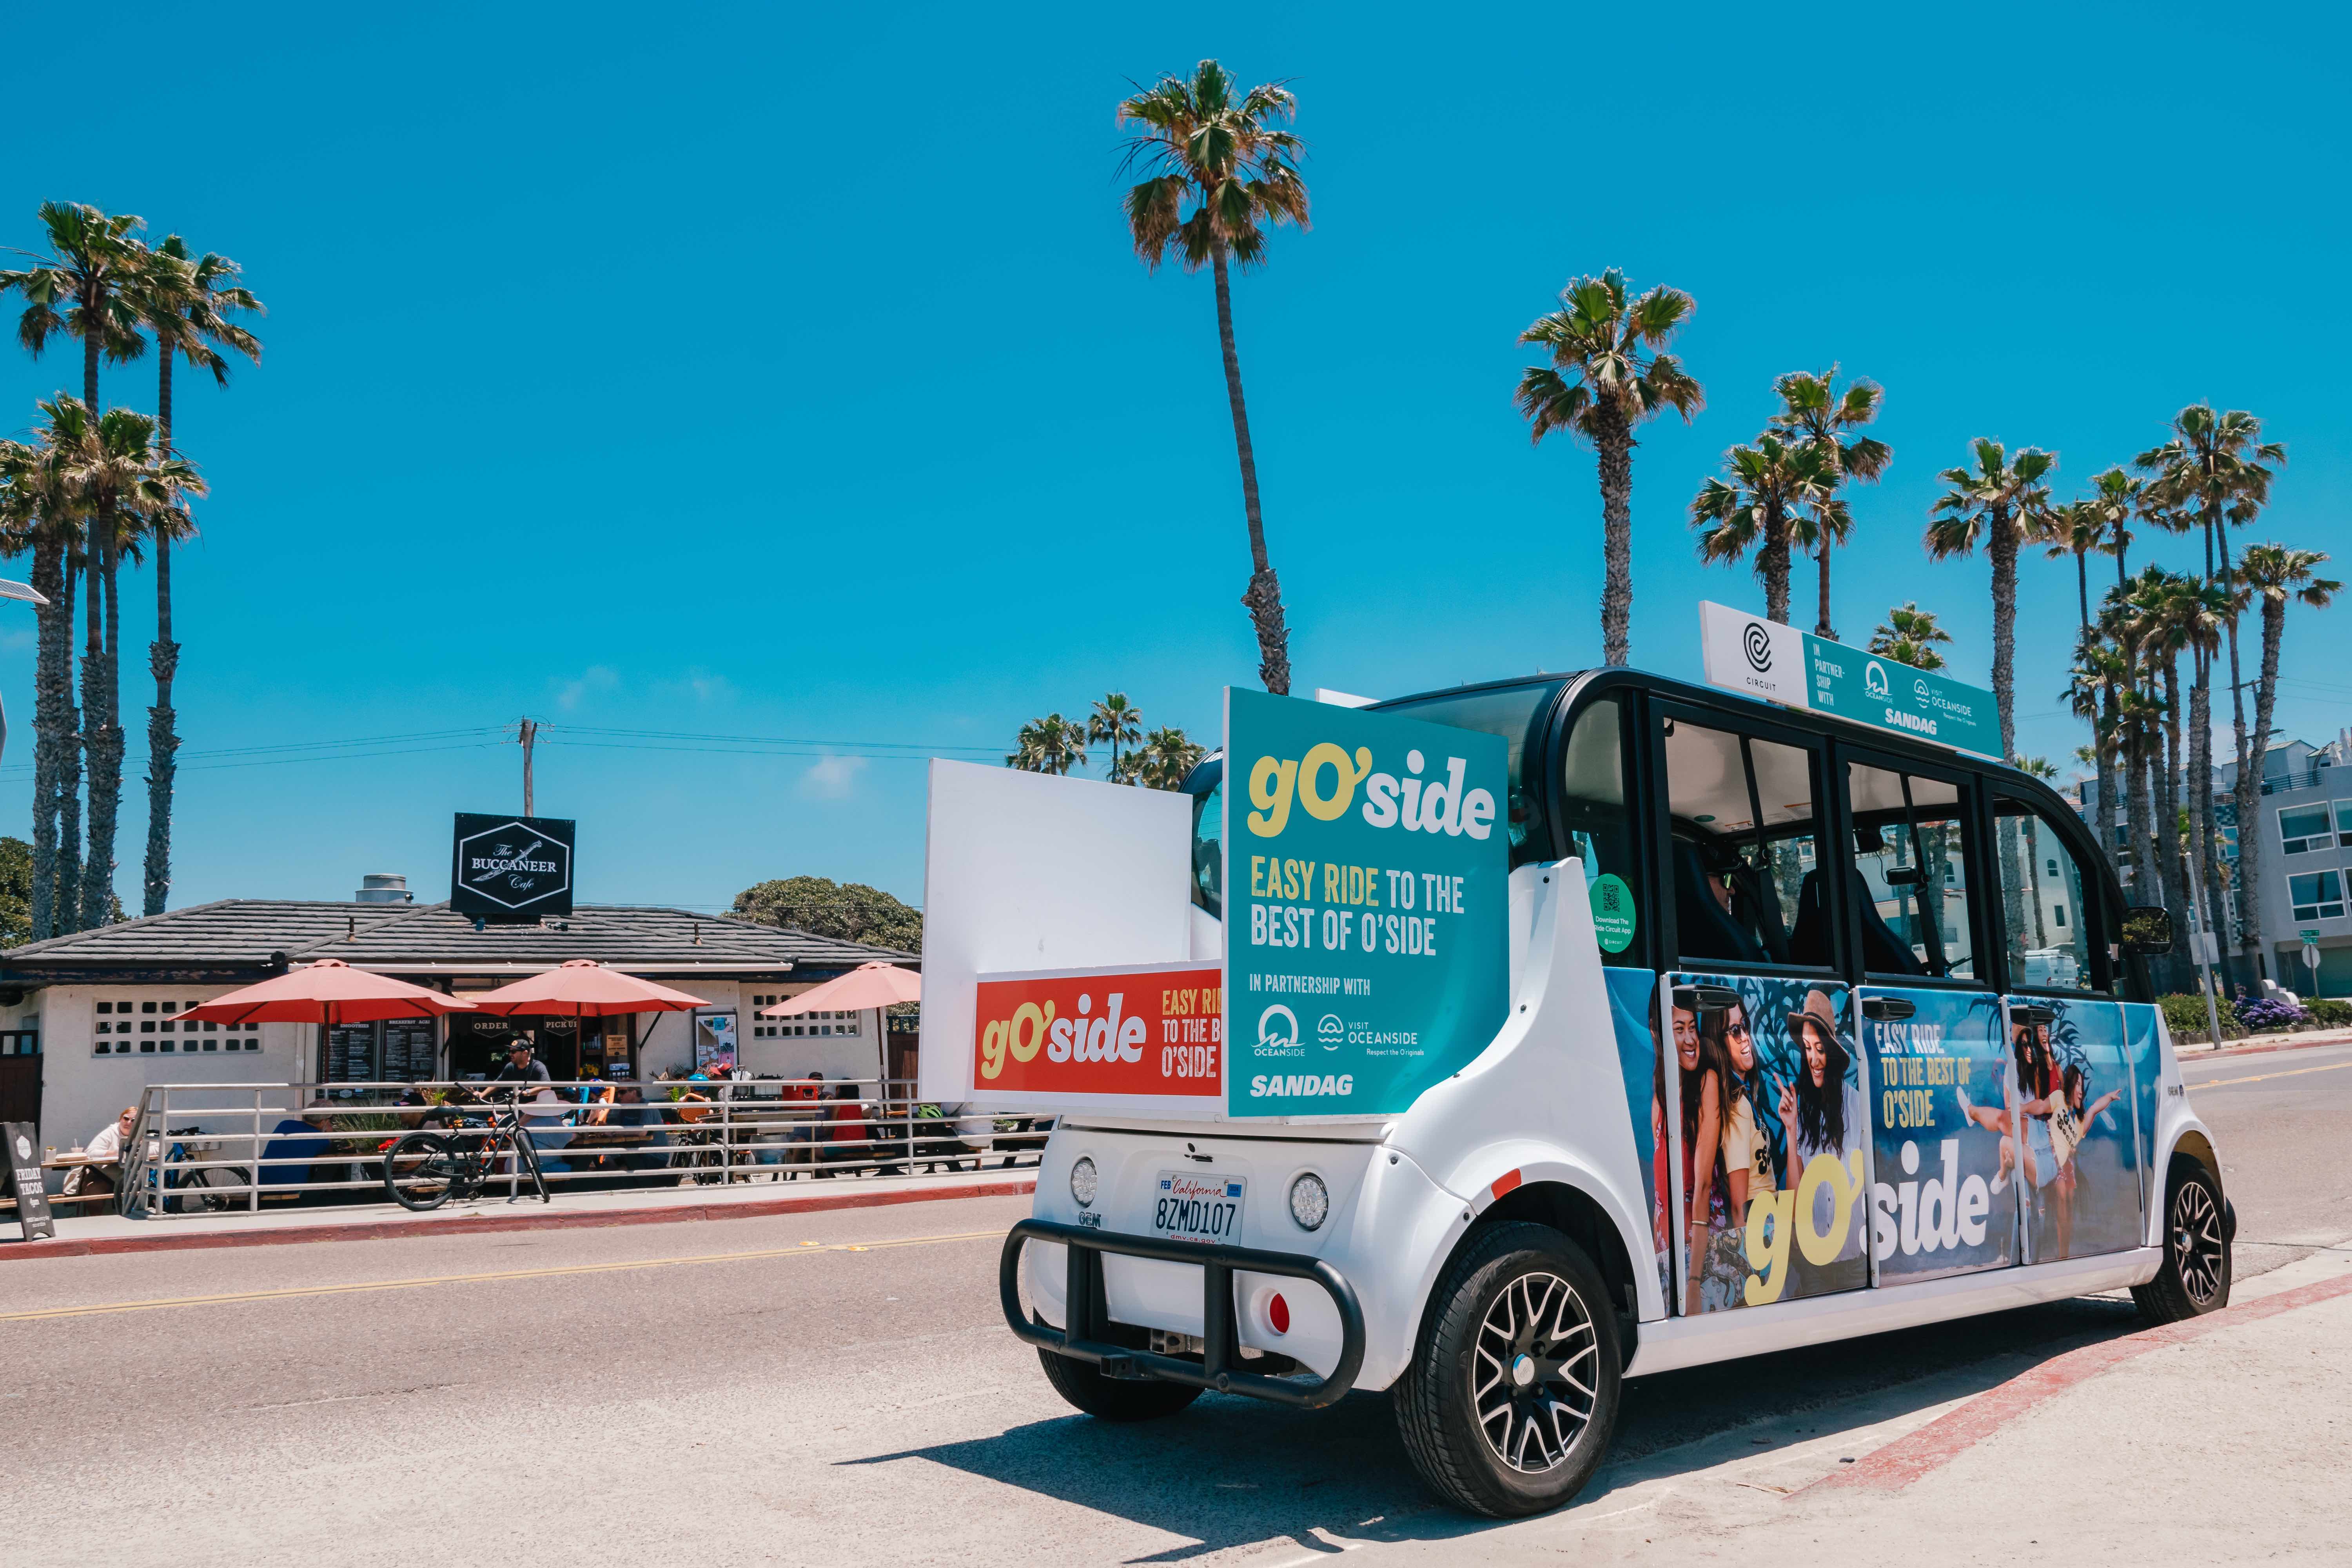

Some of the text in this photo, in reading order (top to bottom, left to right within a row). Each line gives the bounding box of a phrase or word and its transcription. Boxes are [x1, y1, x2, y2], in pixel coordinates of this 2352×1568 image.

[1813, 643, 1820, 657] IN
[1815, 659, 1845, 678] PARTNER-
[1746, 677, 1776, 691] CIRCUIT
[1816, 674, 1831, 689] SHIP
[1817, 690, 1834, 706] WITH
[1865, 691, 1894, 704] OCEANSIDE
[1931, 689, 1942, 697] VISIT
[1932, 697, 1972, 717] OCEANSIDE
[1885, 708, 1937, 735] SANDAG
[493, 844, 512, 856] The
[472, 858, 557, 872] BUCCANEER
[508, 874, 534, 892] Cafe
[1251, 855, 1465, 914] EASY RIDE TO THE
[1251, 904, 1436, 956] BEST OF O'SIDE
[1250, 974, 1370, 996] IN PARTNERSHIP WITH
[1162, 989, 1198, 1015] EASY
[1162, 1019, 1178, 1043] TO
[1182, 1019, 1207, 1042] THE
[1348, 1032, 1417, 1044] OCEANSIDE
[1875, 1023, 1944, 1053] EASY RIDE
[1162, 1046, 1216, 1078] O'SIDE
[1880, 1057, 1971, 1086] TO THE BEST OF
[1250, 1074, 1353, 1097] SANDAG
[1883, 1090, 1935, 1129] O'SIDE
[16, 1168, 41, 1181] FRIDAY
[20, 1182, 43, 1195] TACOS
[1161, 1180, 1171, 1189] FEB
[1173, 1179, 1227, 1200] California
[1079, 1211, 1101, 1227] GEM
[1156, 1198, 1236, 1236] 8ZMD107
[1171, 1234, 1215, 1244] dmv.ca.gov
